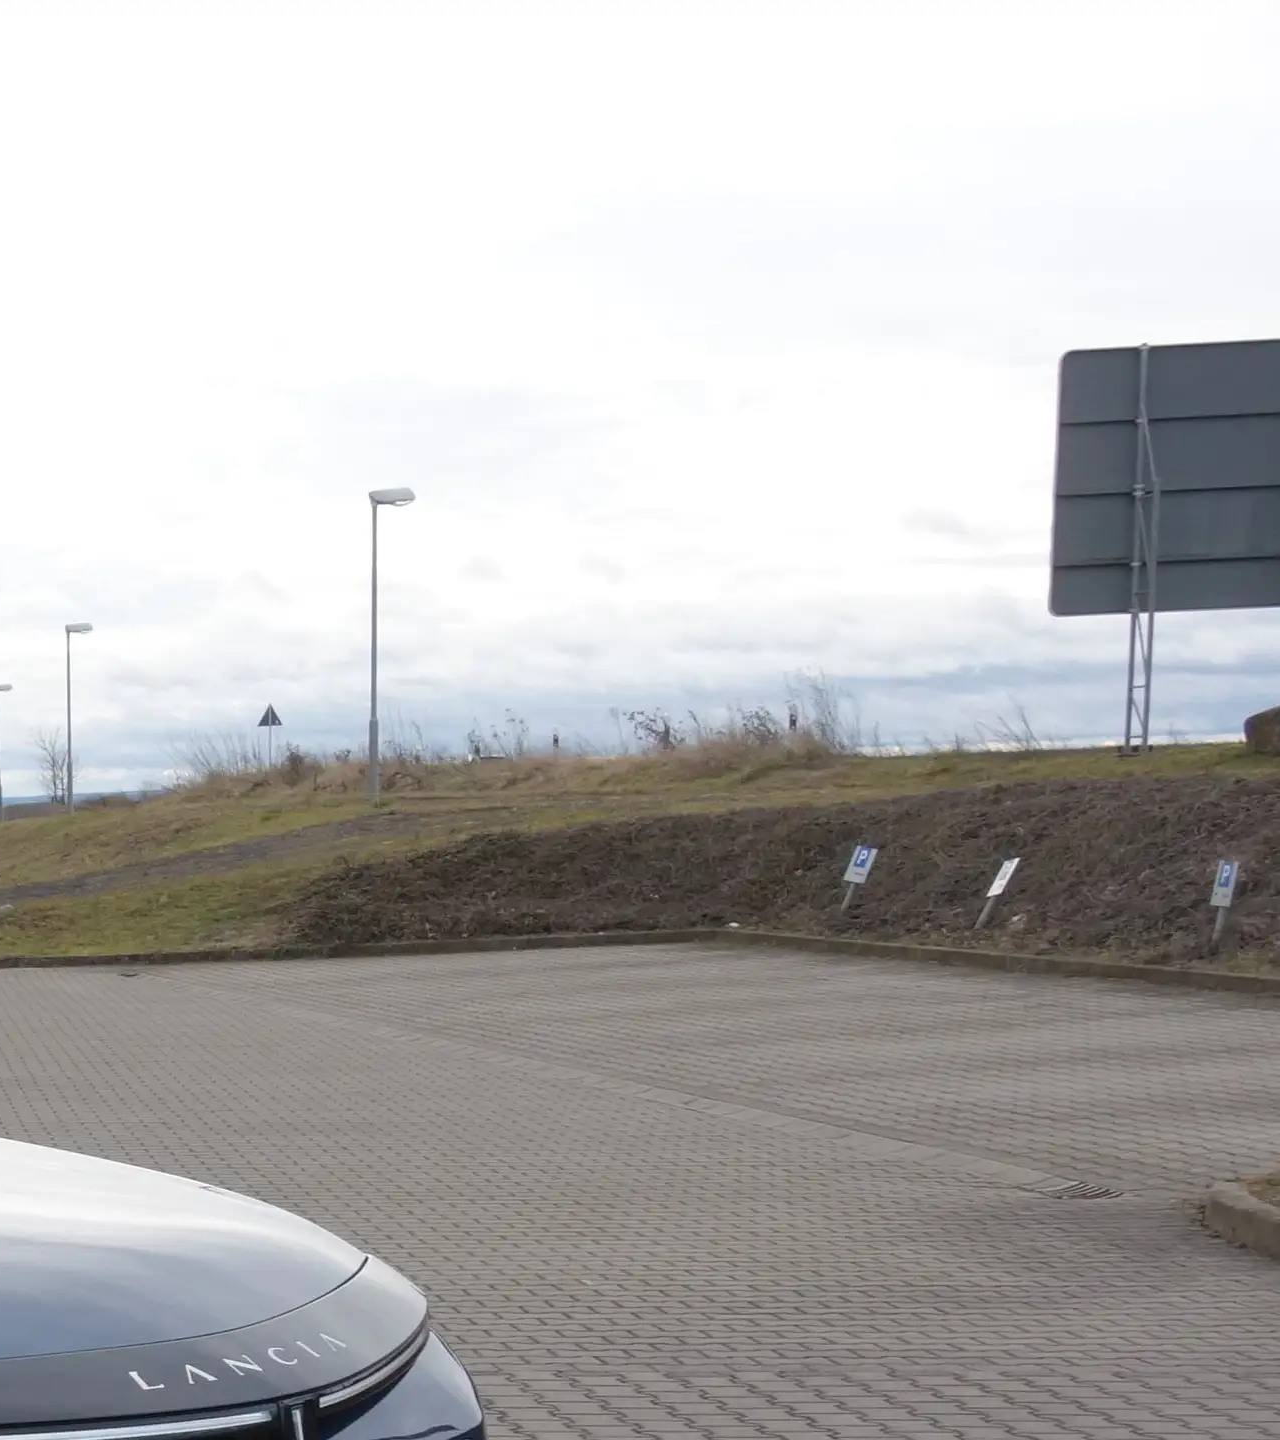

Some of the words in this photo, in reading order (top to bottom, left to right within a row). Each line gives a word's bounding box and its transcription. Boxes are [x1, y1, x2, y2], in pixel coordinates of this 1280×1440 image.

[857, 850, 868, 864] P
[1220, 865, 1230, 884] P
[128, 1332, 347, 1391] LANCIA
